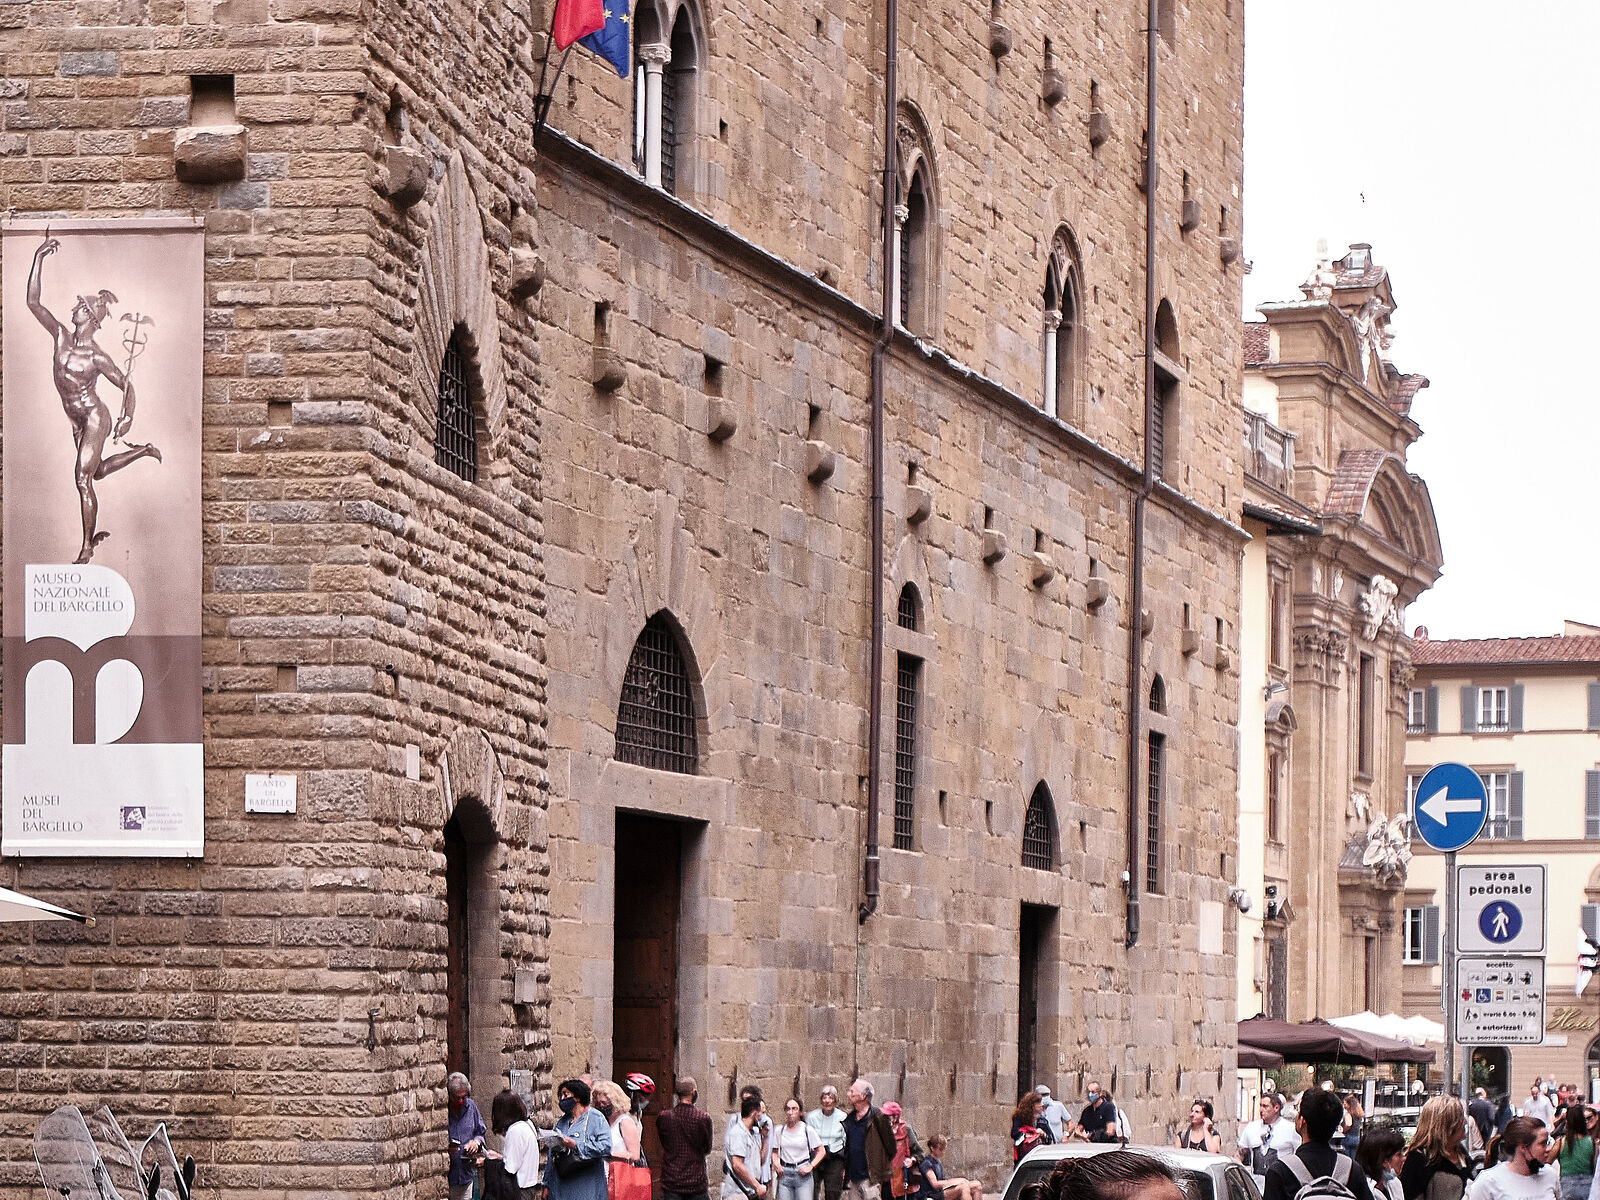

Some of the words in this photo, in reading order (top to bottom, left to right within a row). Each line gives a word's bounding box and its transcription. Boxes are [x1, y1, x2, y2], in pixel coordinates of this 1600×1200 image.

[33, 573, 82, 584] MUSEO
[33, 586, 111, 598] NAZIONALE
[33, 601, 56, 613] DEL
[59, 600, 124, 613] BARGELLO
[256, 780, 287, 788] CANTO
[22, 795, 60, 806] MUSEI
[249, 799, 293, 807] BARGELLO
[22, 808, 43, 819] DEL
[22, 821, 83, 832] BARGELLO
[1485, 872, 1516, 881] area
[1469, 884, 1533, 896] pedonale
[1546, 1008, 1600, 1030] Hotel
